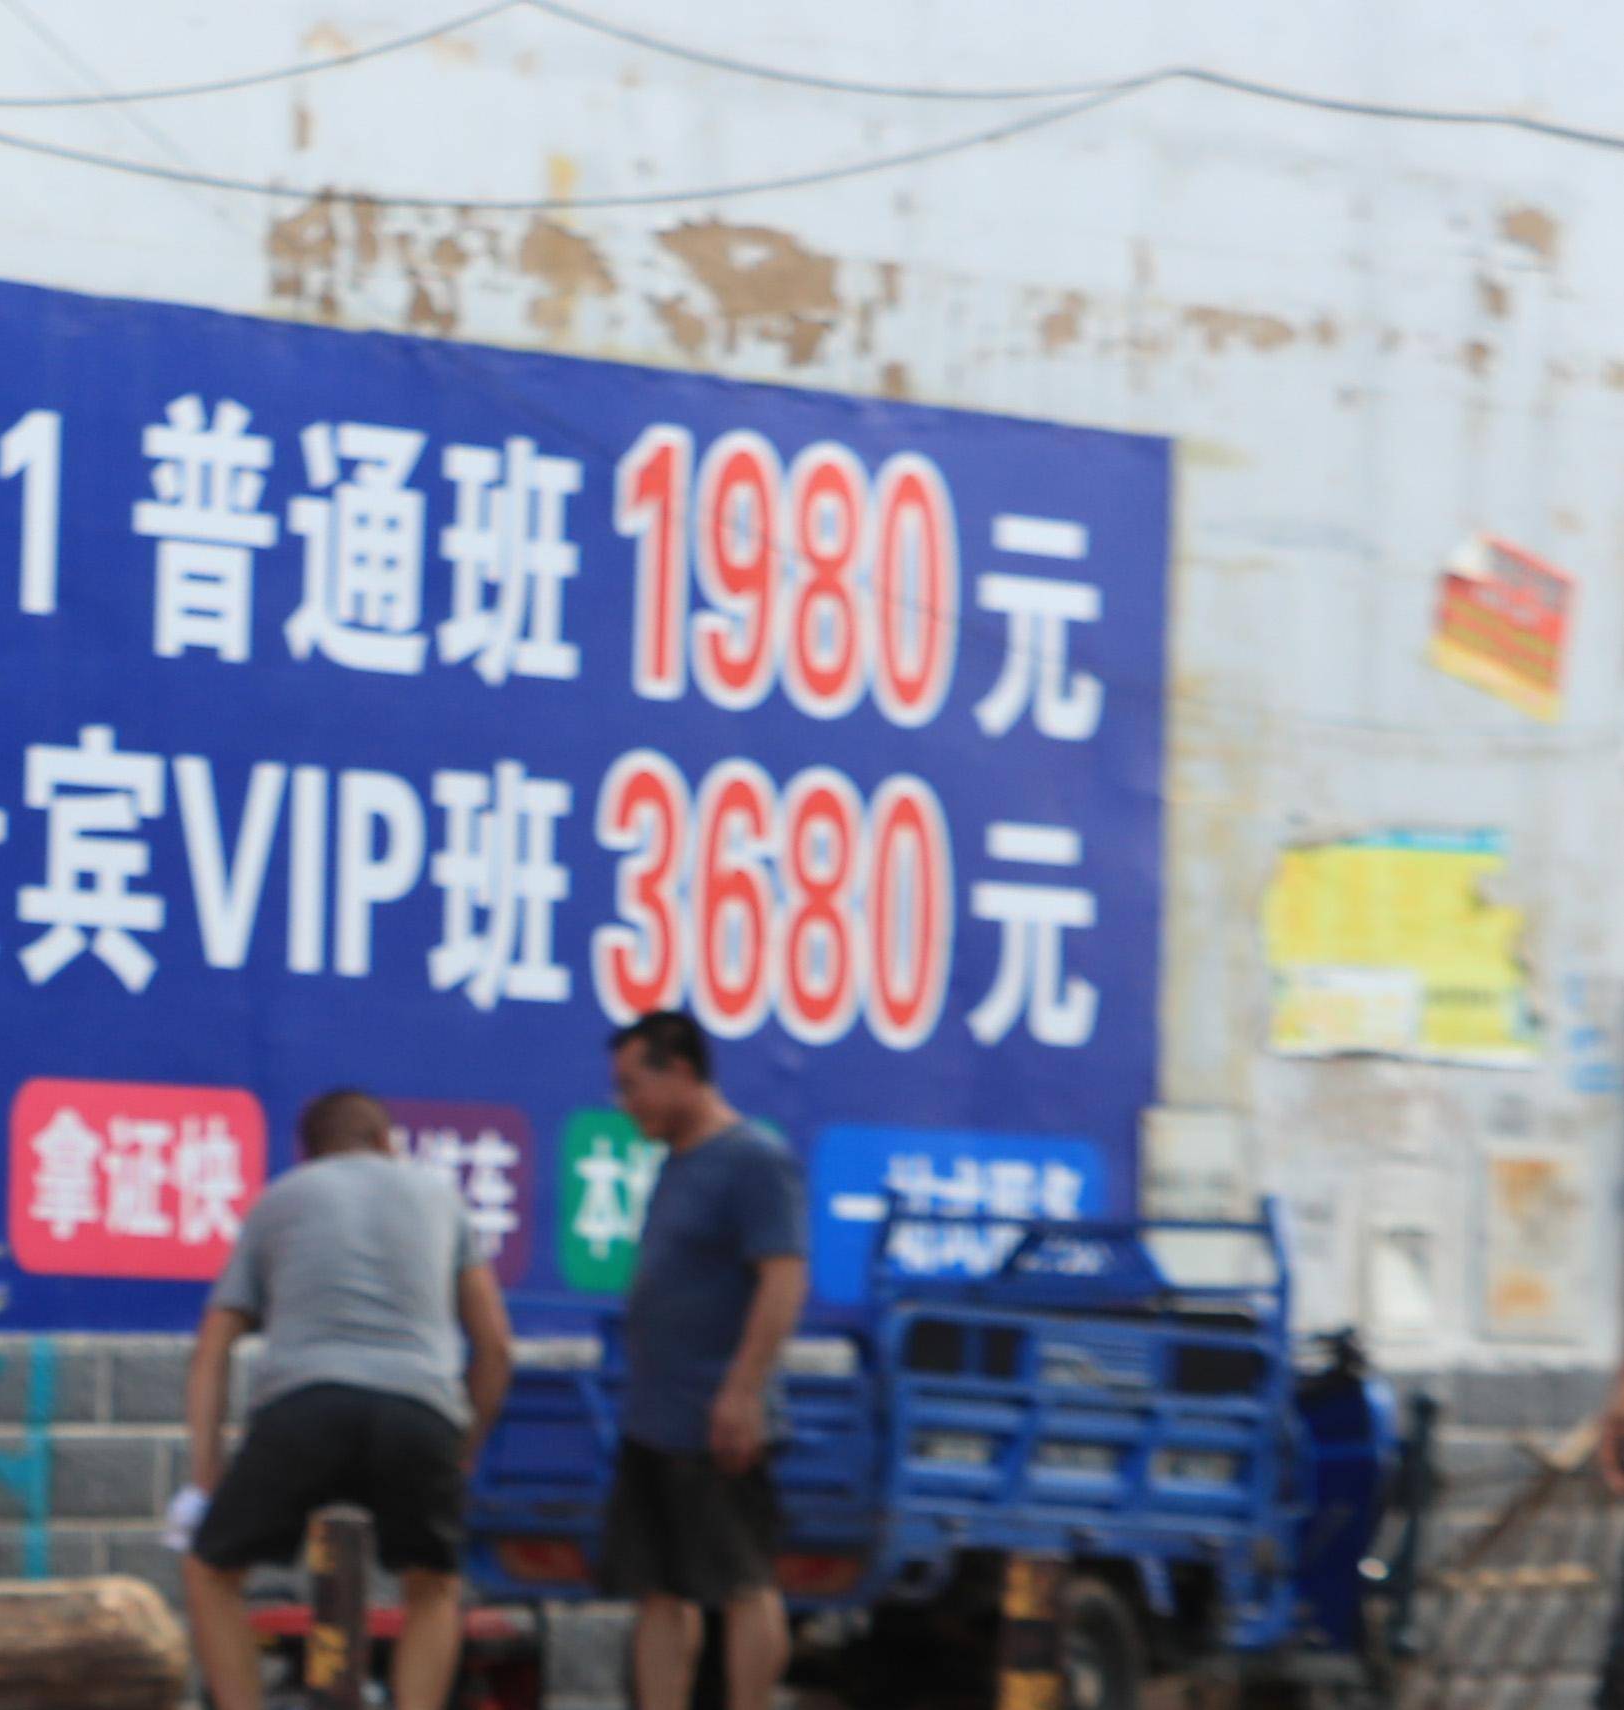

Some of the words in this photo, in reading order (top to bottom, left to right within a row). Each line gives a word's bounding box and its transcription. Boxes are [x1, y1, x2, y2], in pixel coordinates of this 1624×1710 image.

[132, 393, 582, 687] 普通班
[614, 424, 958, 729] 1980
[973, 512, 1103, 742] 元
[593, 747, 954, 1052] 3680
[967, 820, 1099, 1050] 元
[29, 1107, 246, 1243] 拿证快
